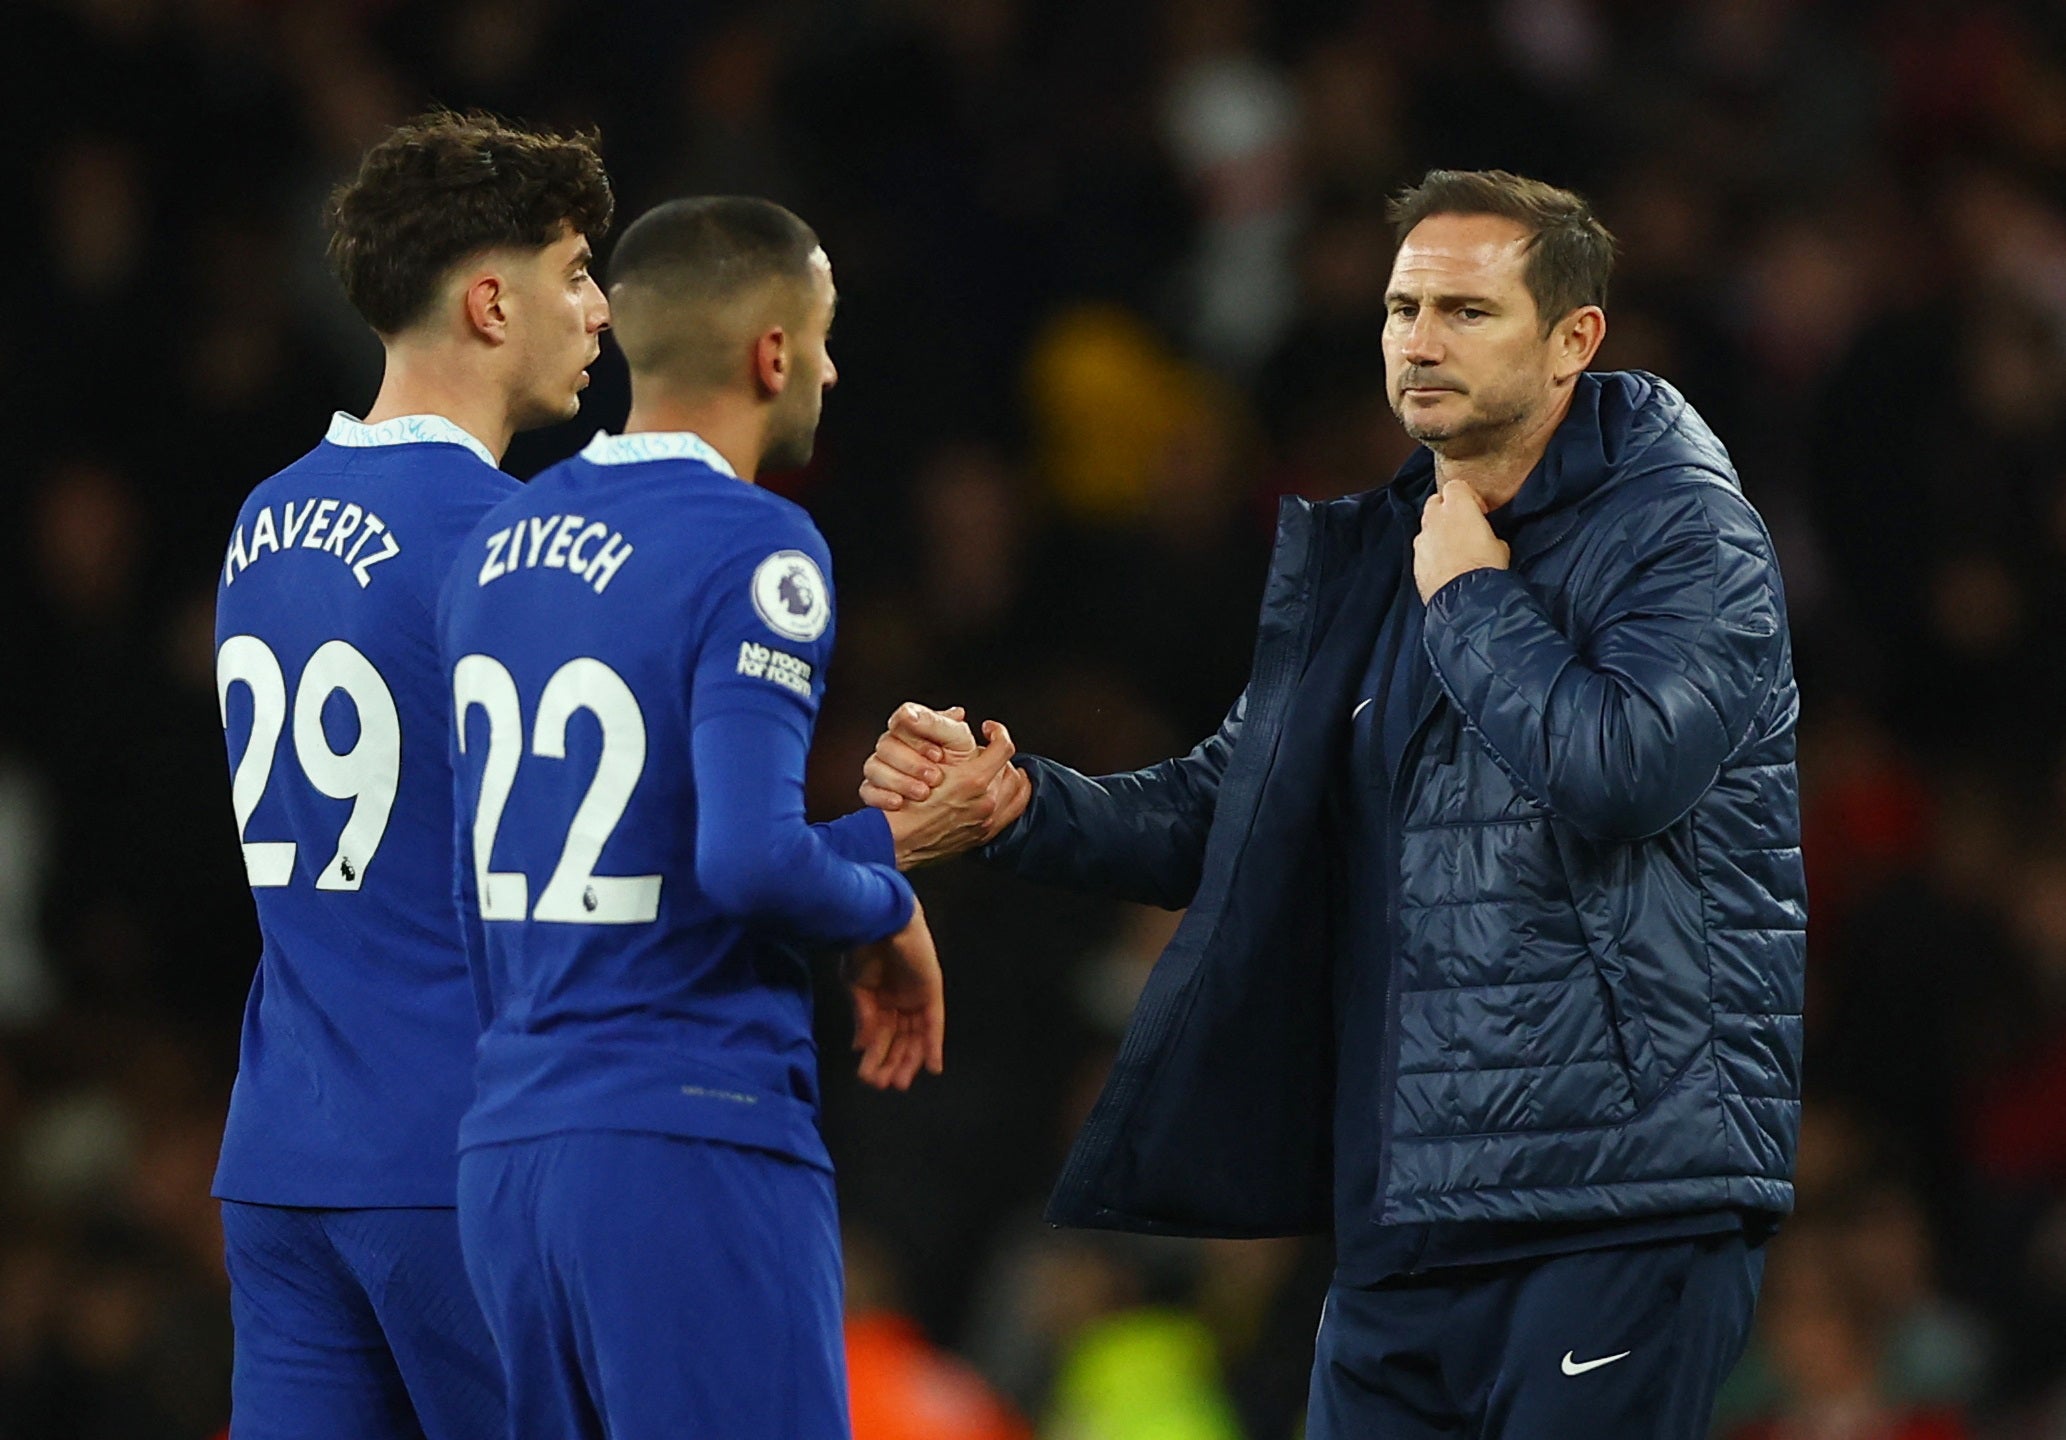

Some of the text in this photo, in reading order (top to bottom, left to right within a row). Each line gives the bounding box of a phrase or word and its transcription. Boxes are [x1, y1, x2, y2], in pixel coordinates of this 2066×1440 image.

[224, 497, 400, 589] HAVERTZ
[477, 514, 634, 595] ZIYECH
[736, 659, 768, 679] for
[740, 641, 770, 663] No
[216, 635, 401, 891] 29
[453, 654, 662, 924] 22
